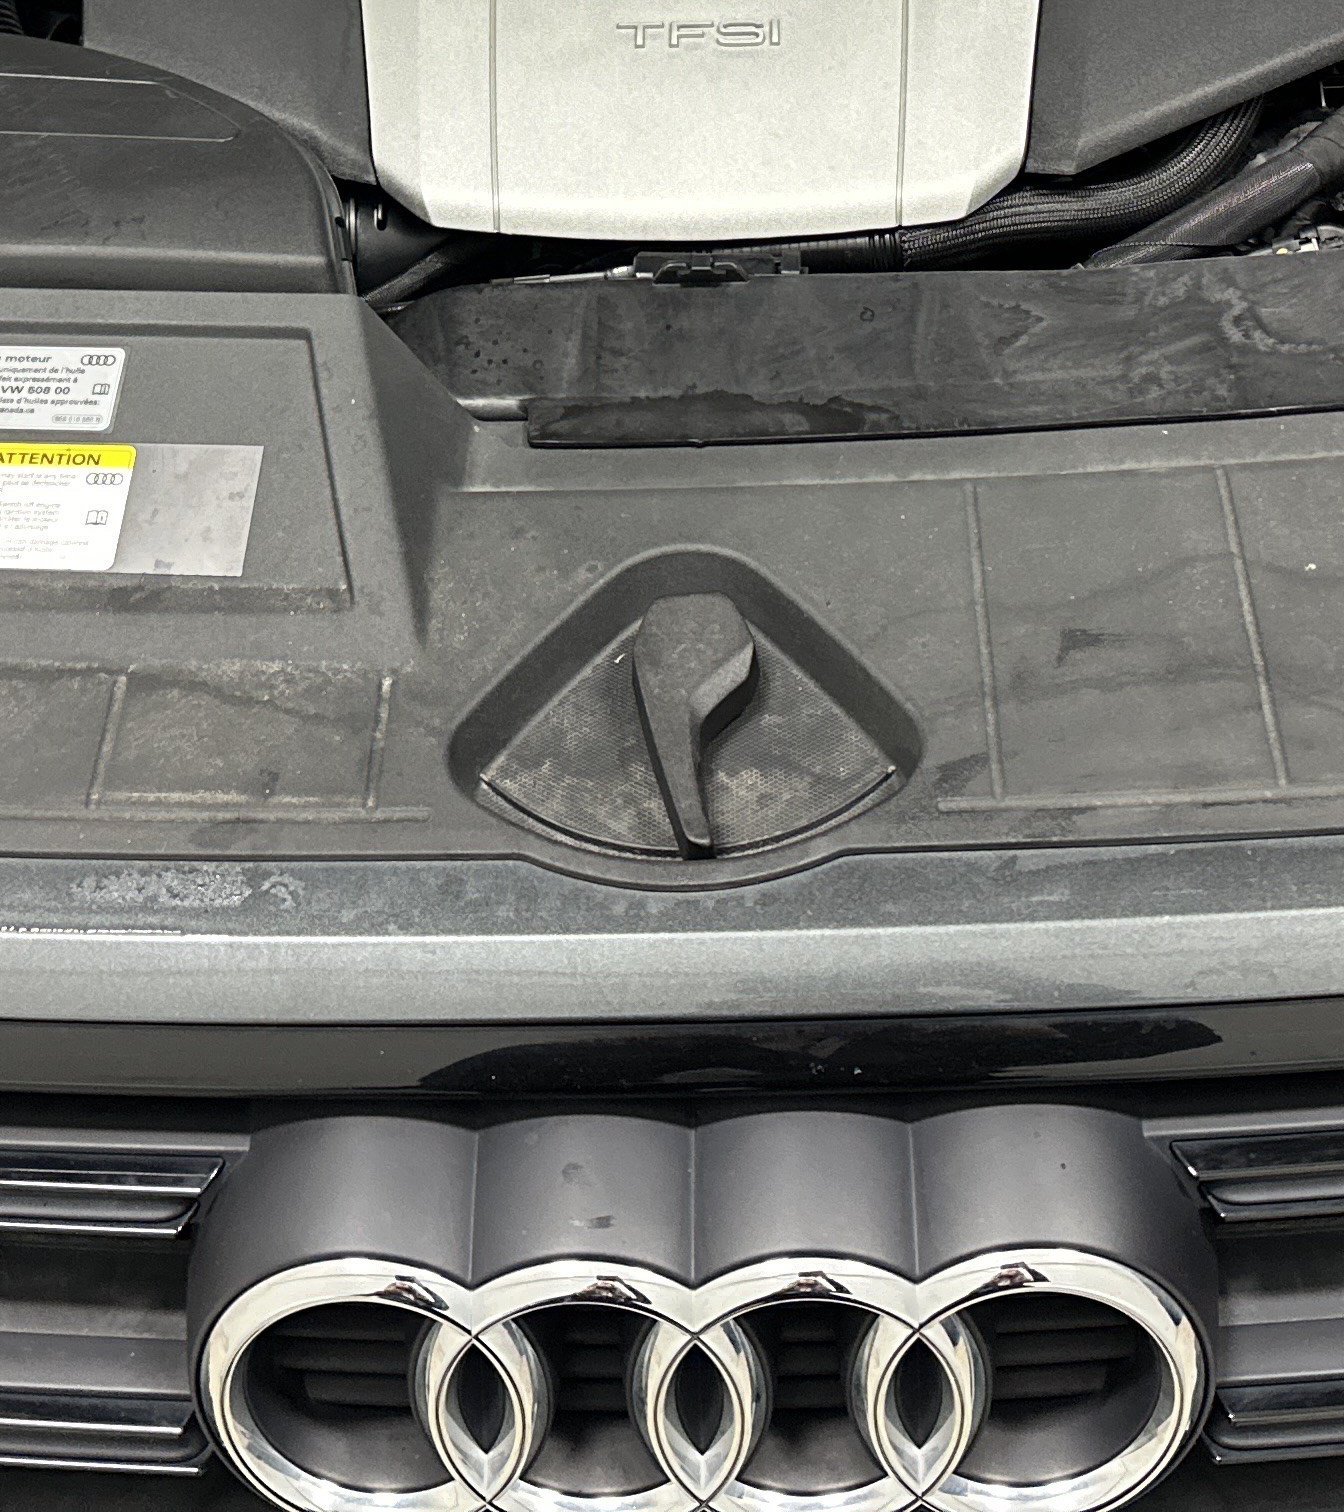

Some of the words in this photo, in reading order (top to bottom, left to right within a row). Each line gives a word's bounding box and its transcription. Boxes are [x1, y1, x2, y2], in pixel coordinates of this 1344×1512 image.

[616, 18, 781, 49] TFSI
[5, 355, 52, 363] moteur
[1, 385, 24, 394] VW
[54, 386, 71, 395] 00
